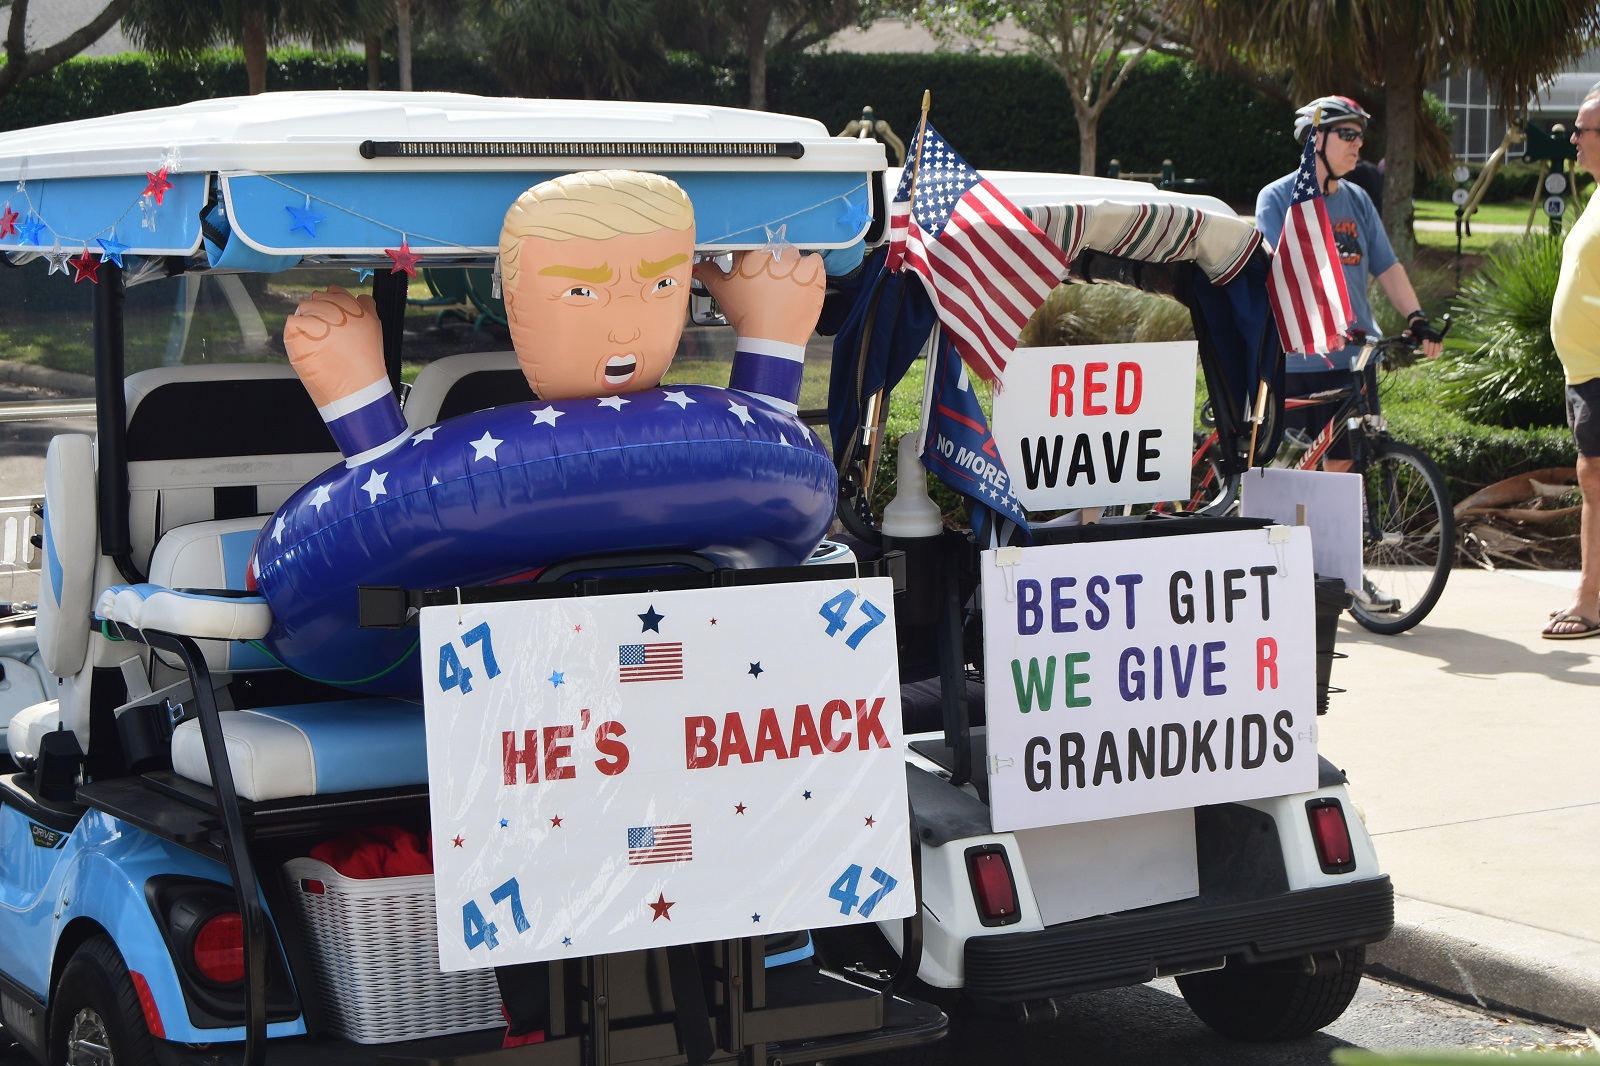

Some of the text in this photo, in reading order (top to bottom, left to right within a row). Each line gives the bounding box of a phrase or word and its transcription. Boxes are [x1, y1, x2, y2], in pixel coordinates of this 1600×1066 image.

[1050, 362, 1142, 417] RED
[937, 433, 954, 458] NO
[955, 447, 1008, 490] MORE
[1021, 428, 1162, 490] WAVE
[819, 590, 886, 650] 47
[1017, 566, 1277, 635] BEST GIFT
[439, 622, 501, 694] 47
[1011, 637, 1278, 713] WE GIVE R
[502, 698, 891, 786] HE'S BAAACK
[1024, 710, 1294, 792] GRANDKIDS
[463, 877, 530, 950] 47
[829, 864, 898, 918] 47
